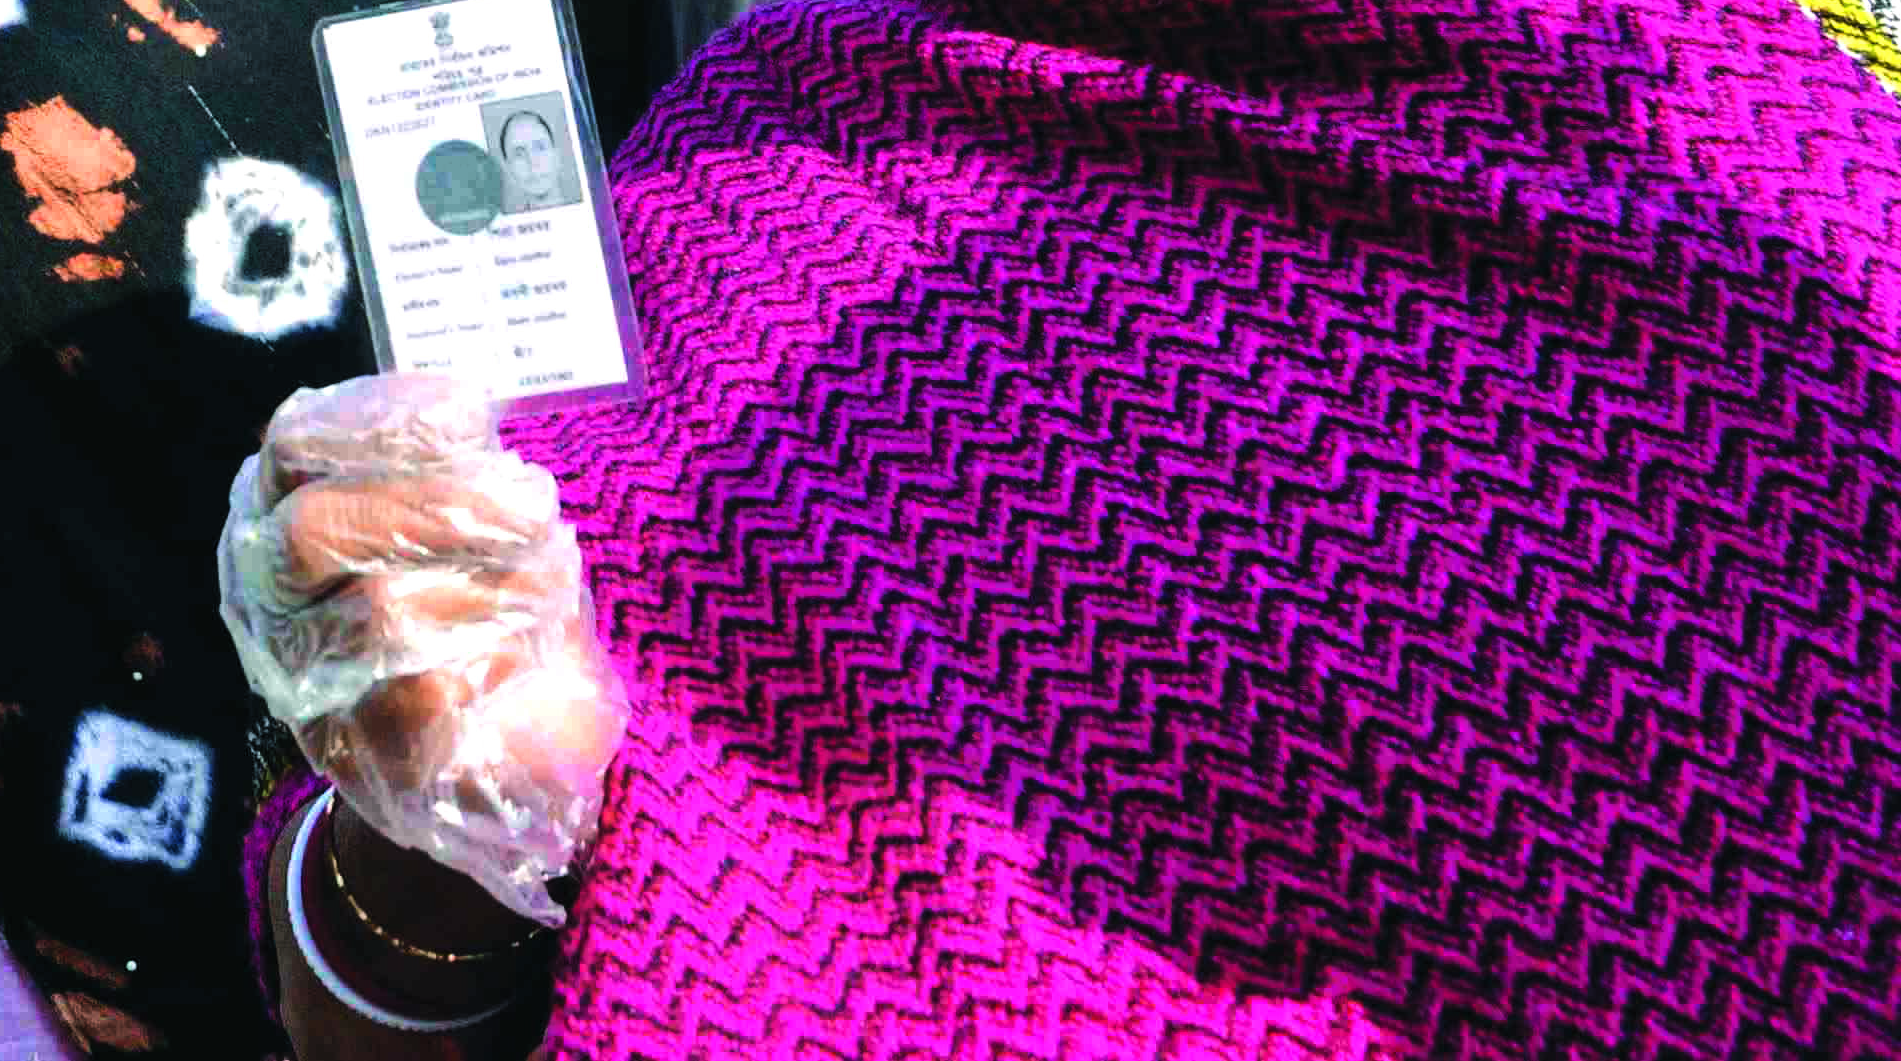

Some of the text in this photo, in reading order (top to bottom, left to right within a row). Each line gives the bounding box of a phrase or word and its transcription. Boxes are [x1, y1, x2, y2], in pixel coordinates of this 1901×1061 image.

[367, 90, 420, 106] ELECTION
[423, 77, 493, 95] COMMISSION
[495, 72, 508, 82] OF
